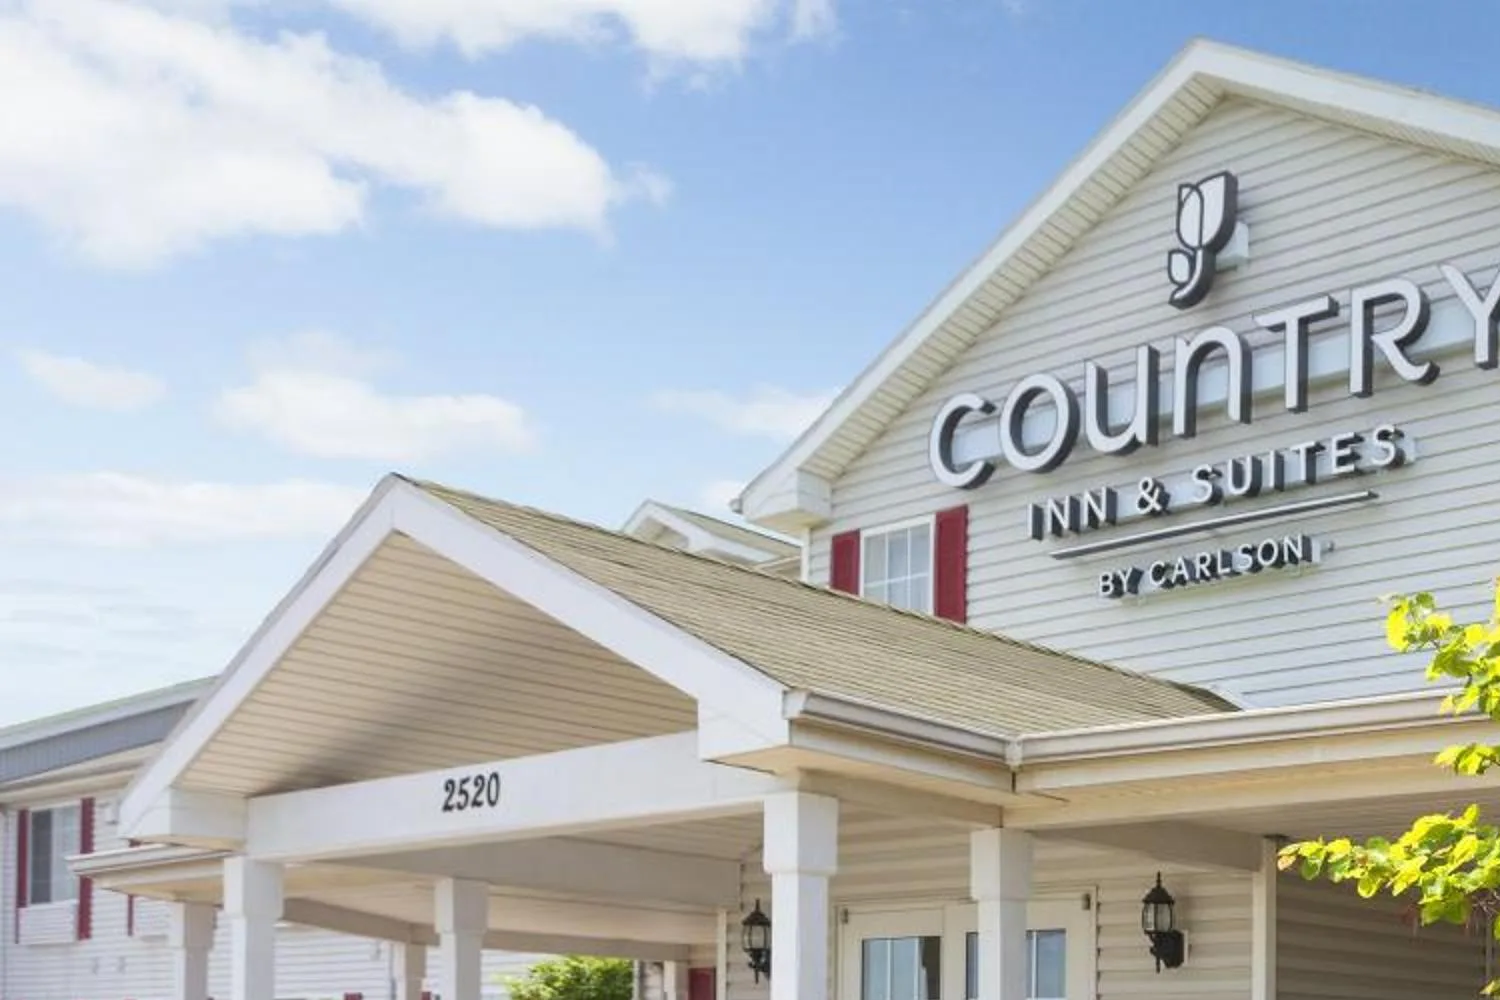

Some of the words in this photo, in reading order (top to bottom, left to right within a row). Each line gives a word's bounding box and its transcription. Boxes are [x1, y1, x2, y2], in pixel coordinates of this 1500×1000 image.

[1027, 485, 1117, 541] INN
[1135, 475, 1171, 516] &
[1191, 424, 1406, 505] SUITES
[1099, 567, 1143, 598] BY
[1149, 534, 1311, 589] CARLSON
[442, 771, 500, 812] 2520
